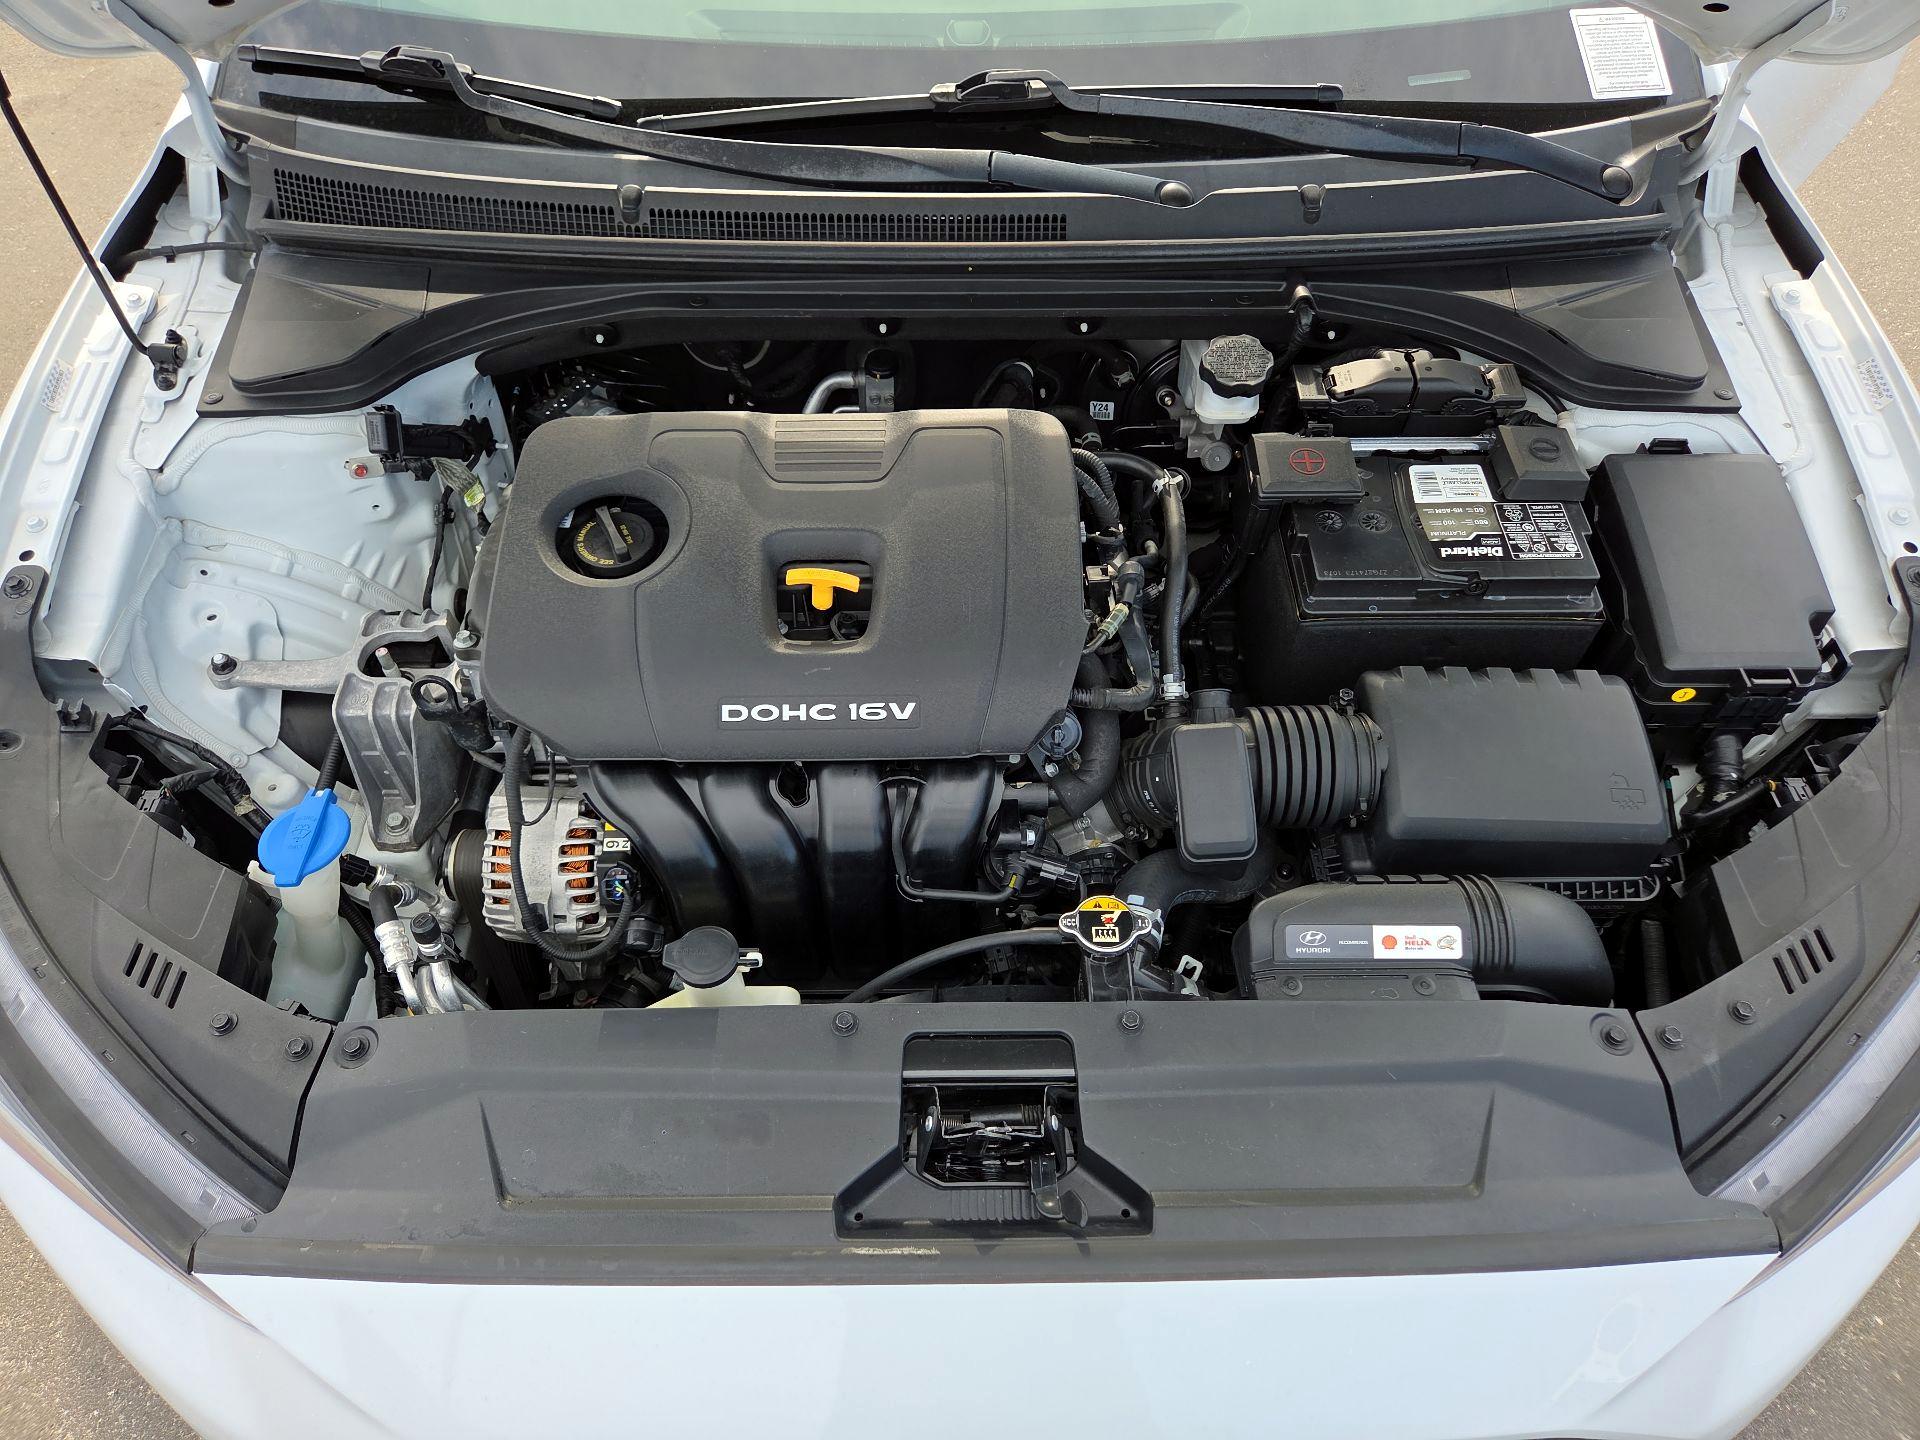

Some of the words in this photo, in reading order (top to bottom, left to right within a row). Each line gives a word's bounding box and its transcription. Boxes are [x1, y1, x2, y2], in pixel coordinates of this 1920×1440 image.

[1092, 402, 1109, 412] Y24
[1440, 546, 1504, 558] DieHard
[1678, 691, 1690, 699] J
[720, 703, 838, 722] DOHC
[848, 702, 917, 721] 16V
[1061, 918, 1076, 926] HCC
[1137, 919, 1149, 927] 1.1
